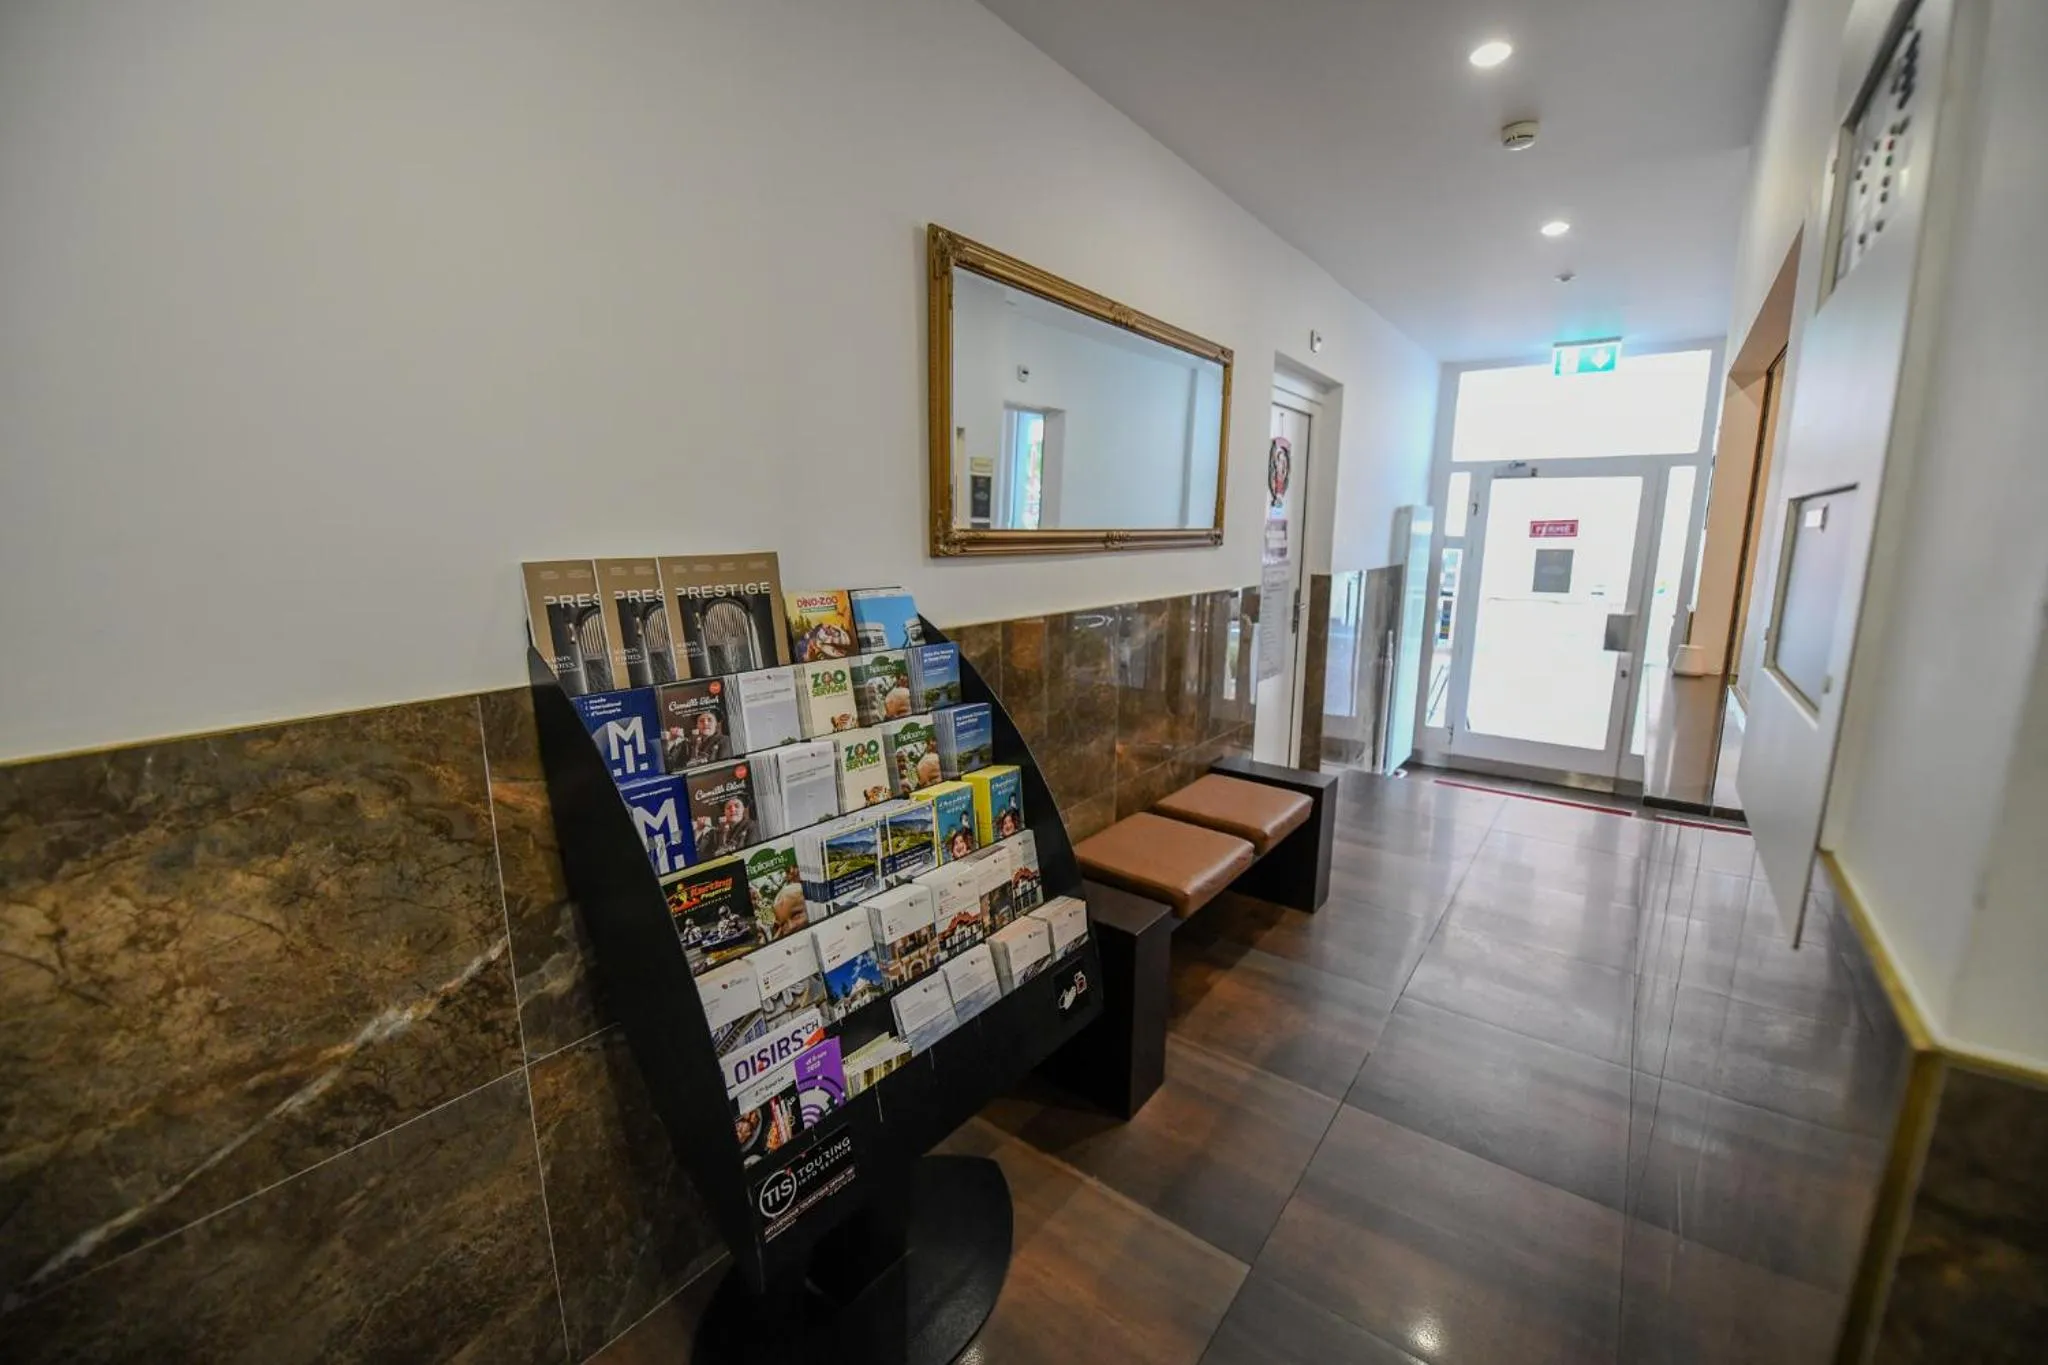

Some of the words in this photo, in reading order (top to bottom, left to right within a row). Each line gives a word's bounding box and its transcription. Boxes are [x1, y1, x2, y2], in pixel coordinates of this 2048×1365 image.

[675, 582, 771, 600] PRESTIGE
[811, 670, 846, 688] ZOO
[845, 740, 879, 761] ZOO
[796, 1136, 850, 1178] TOURING
[763, 1178, 793, 1207] TIS
